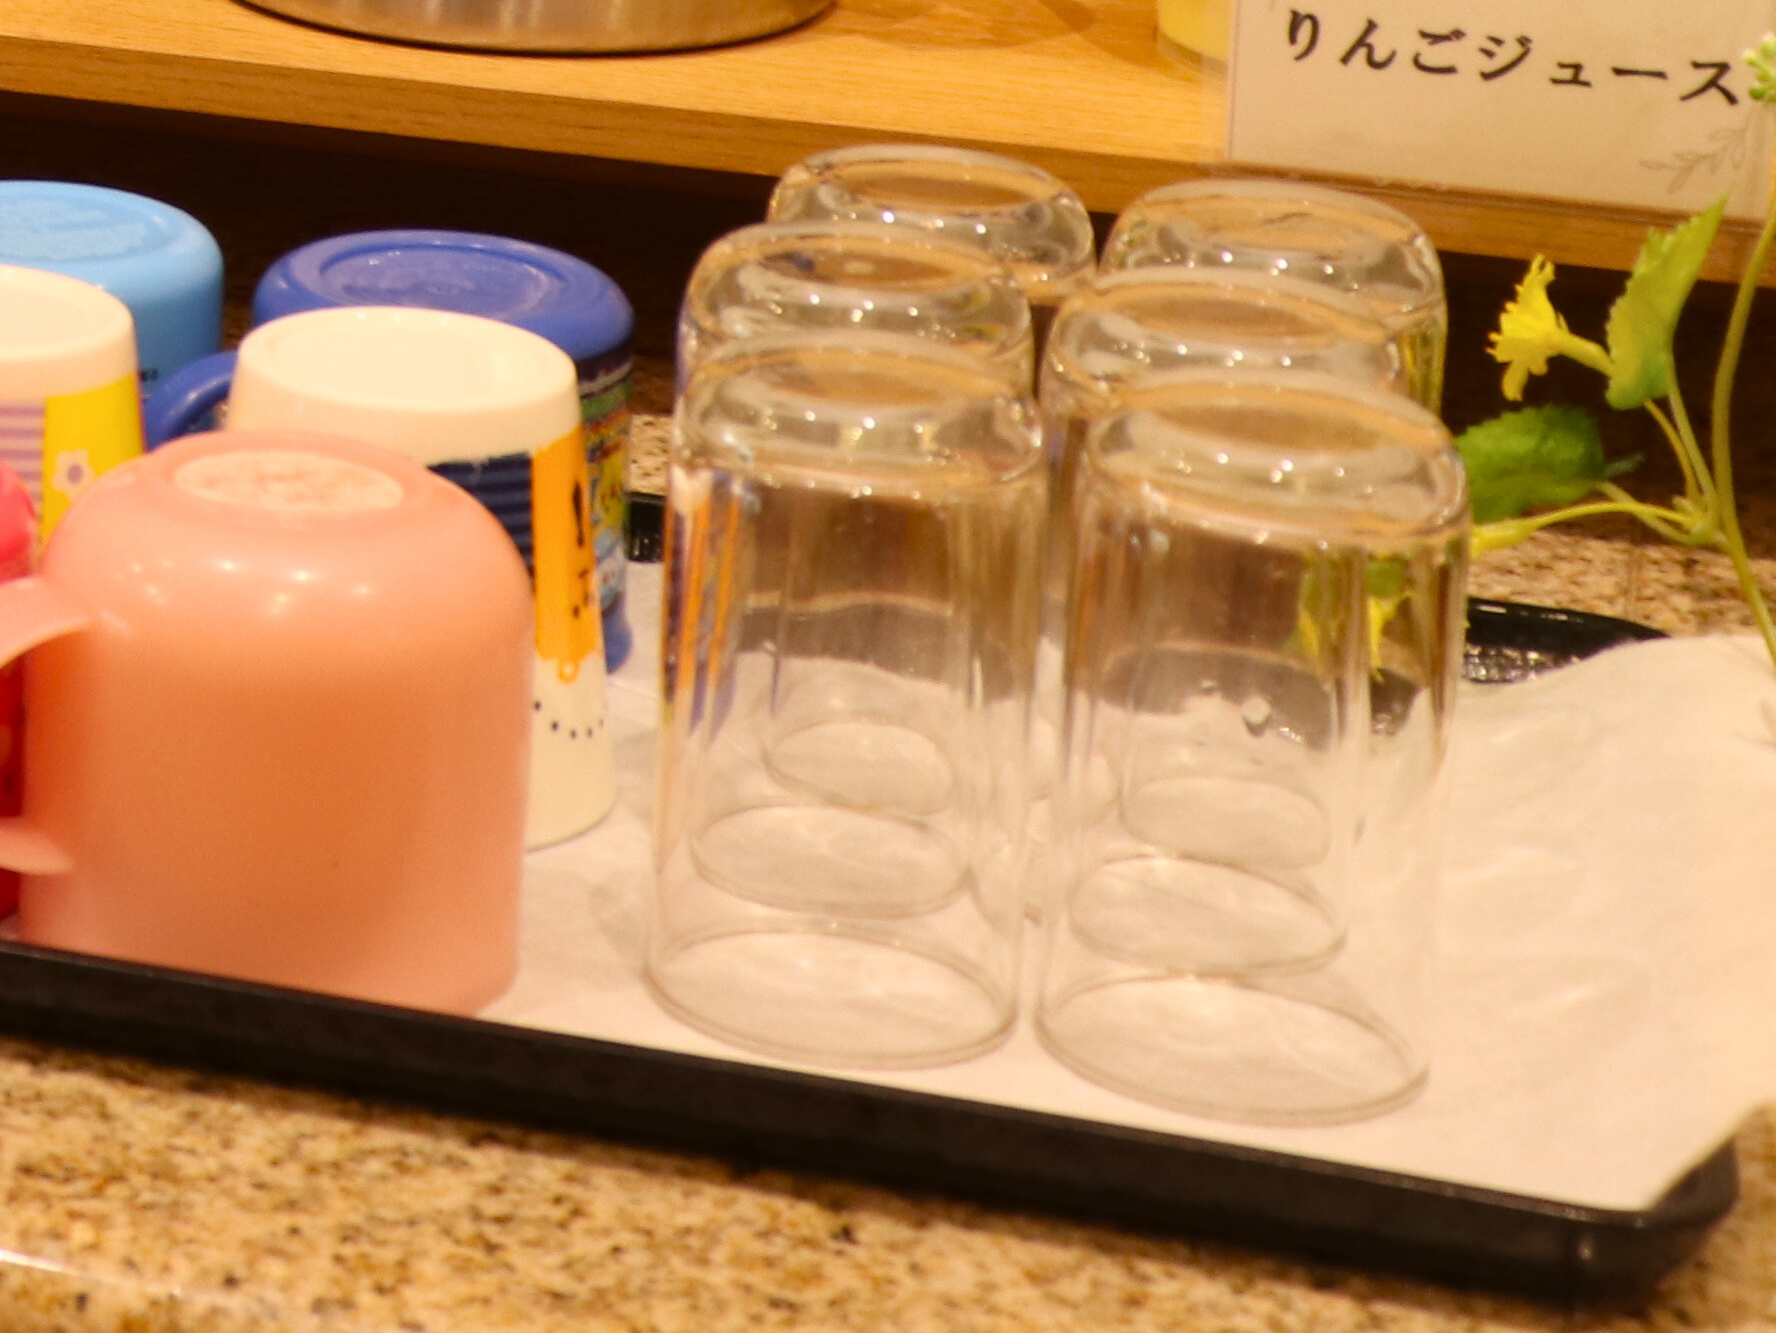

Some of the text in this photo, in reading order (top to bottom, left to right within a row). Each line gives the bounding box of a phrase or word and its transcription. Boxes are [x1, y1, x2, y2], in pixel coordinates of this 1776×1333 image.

[1287, 8, 1739, 107] りんごジュース
